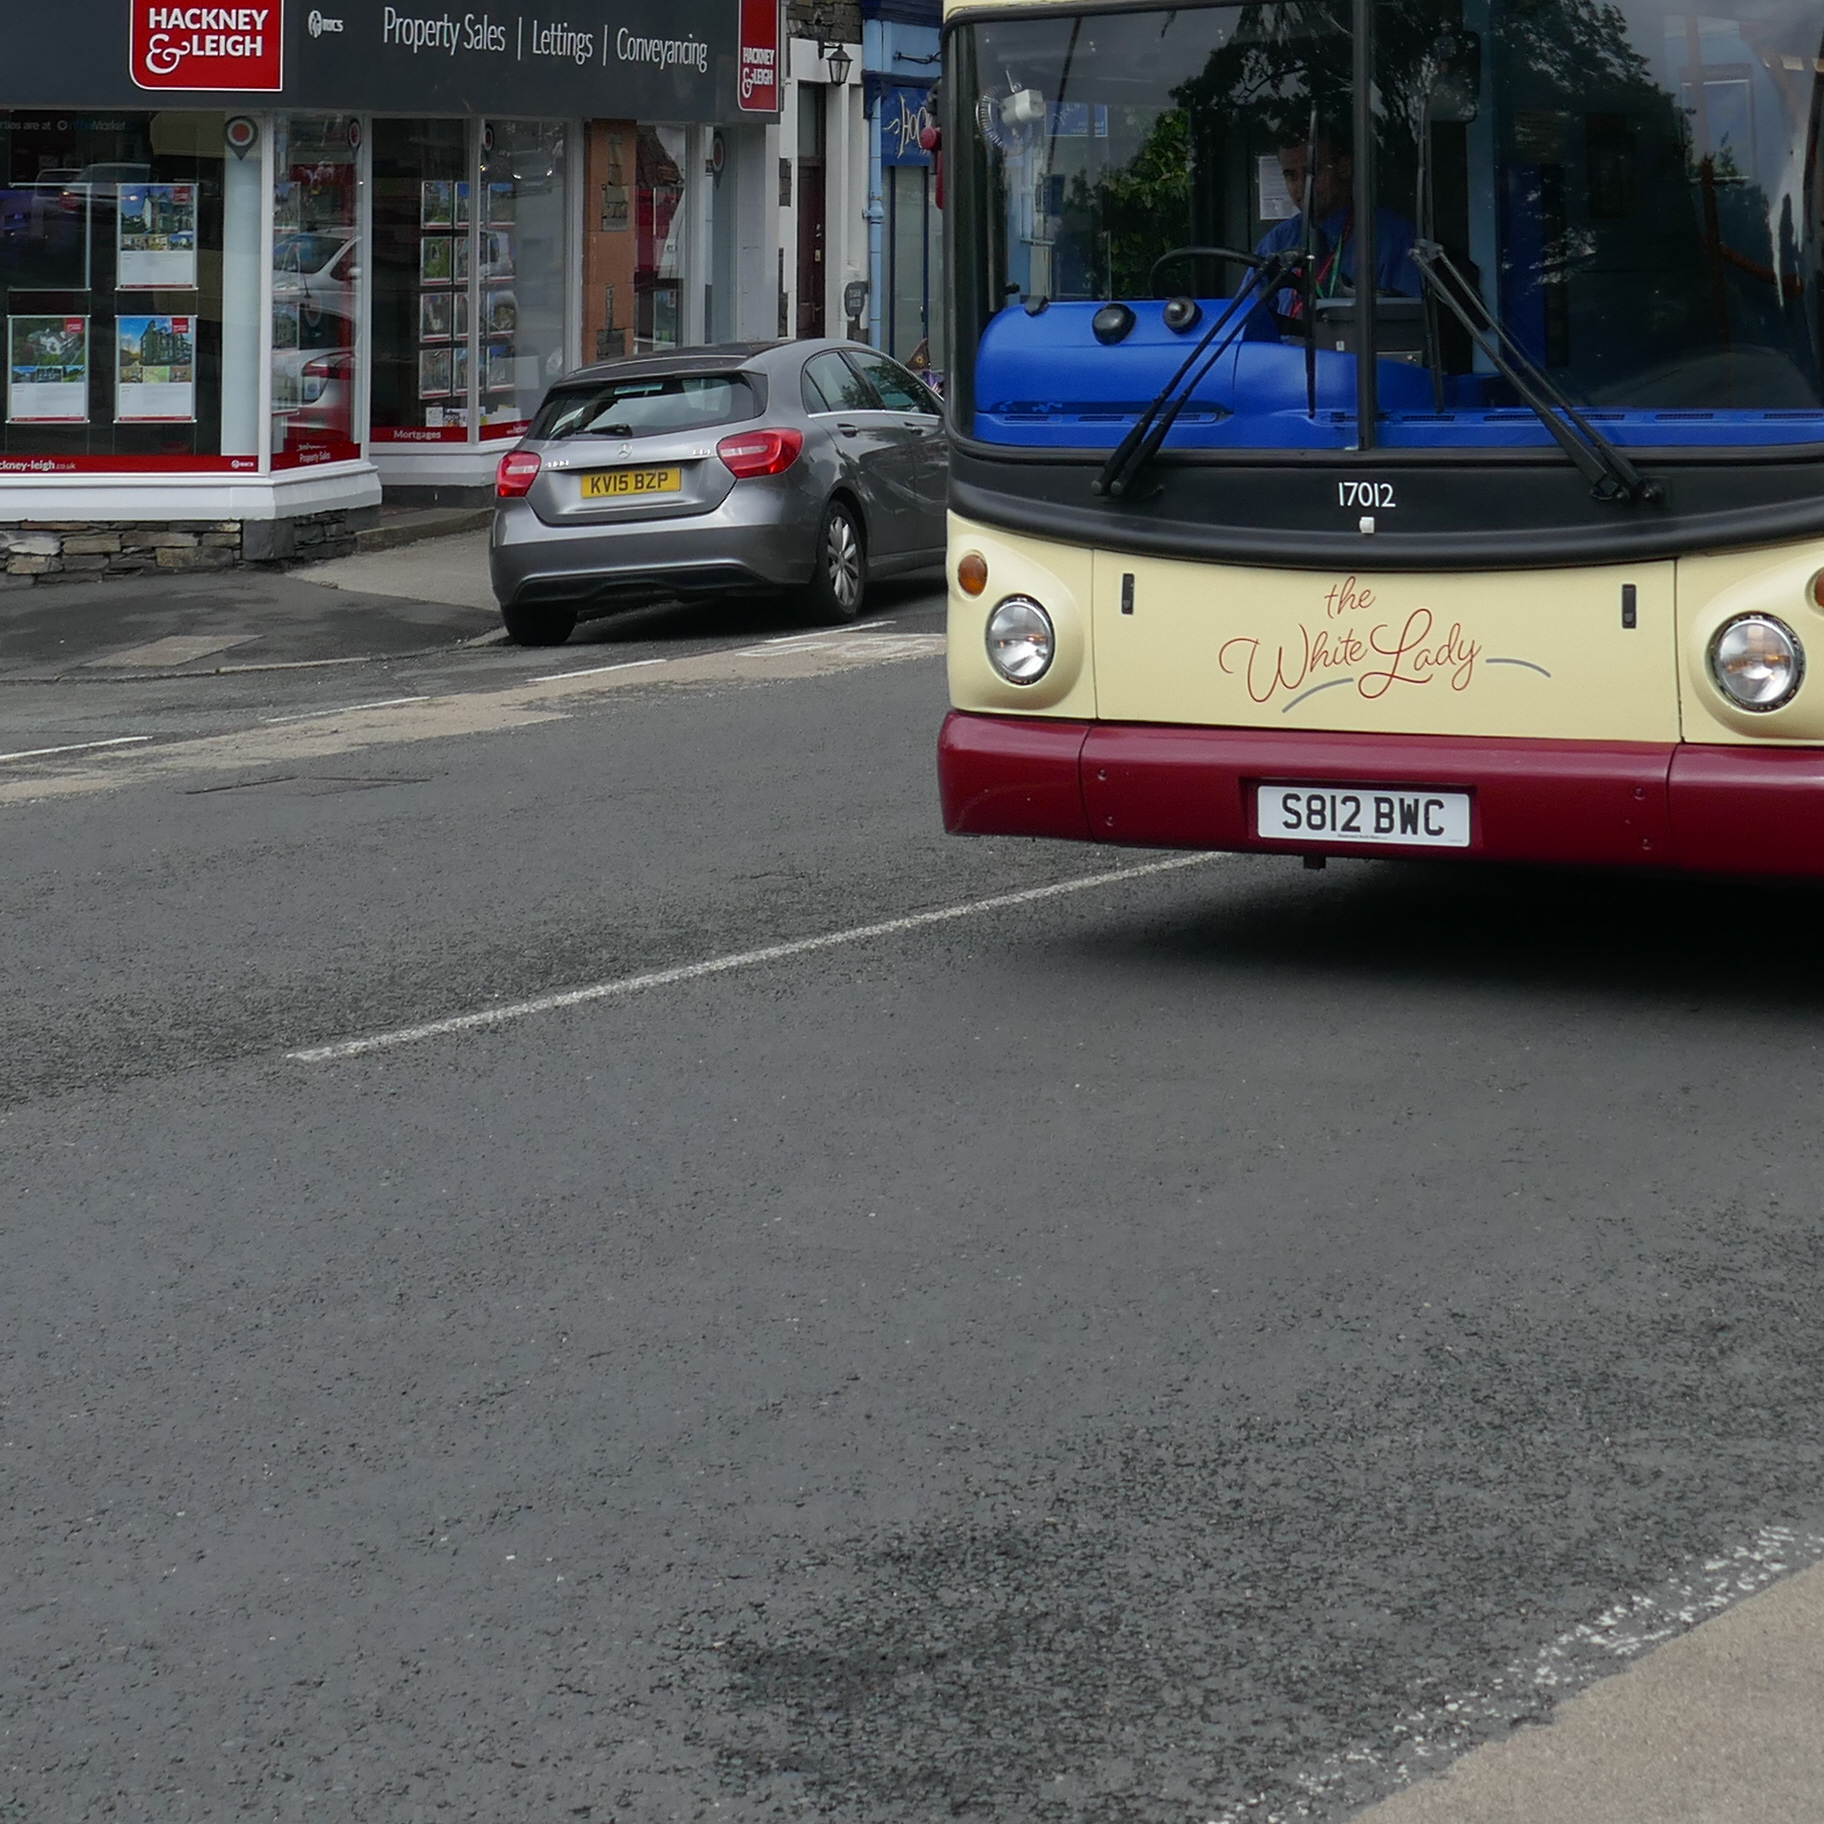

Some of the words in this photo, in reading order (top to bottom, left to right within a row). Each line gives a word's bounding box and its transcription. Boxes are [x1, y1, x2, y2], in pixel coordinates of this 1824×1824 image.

[148, 6, 268, 31] HACKNEY
[192, 34, 263, 57] LEIGH
[383, 6, 461, 56] Property
[463, 13, 506, 52] Sales
[532, 19, 593, 65] Lettings
[616, 27, 708, 73] Conveyancing
[742, 46, 775, 66] HACKNEY
[393, 429, 442, 441] Mortgages
[591, 475, 628, 494] KV15
[634, 472, 669, 490] BZP
[1338, 481, 1397, 508] 17012
[1324, 575, 1376, 619] the
[1218, 624, 1368, 703] White
[1357, 608, 1482, 700] Lady
[1281, 792, 1361, 832] S812
[1374, 796, 1445, 836] BWC
